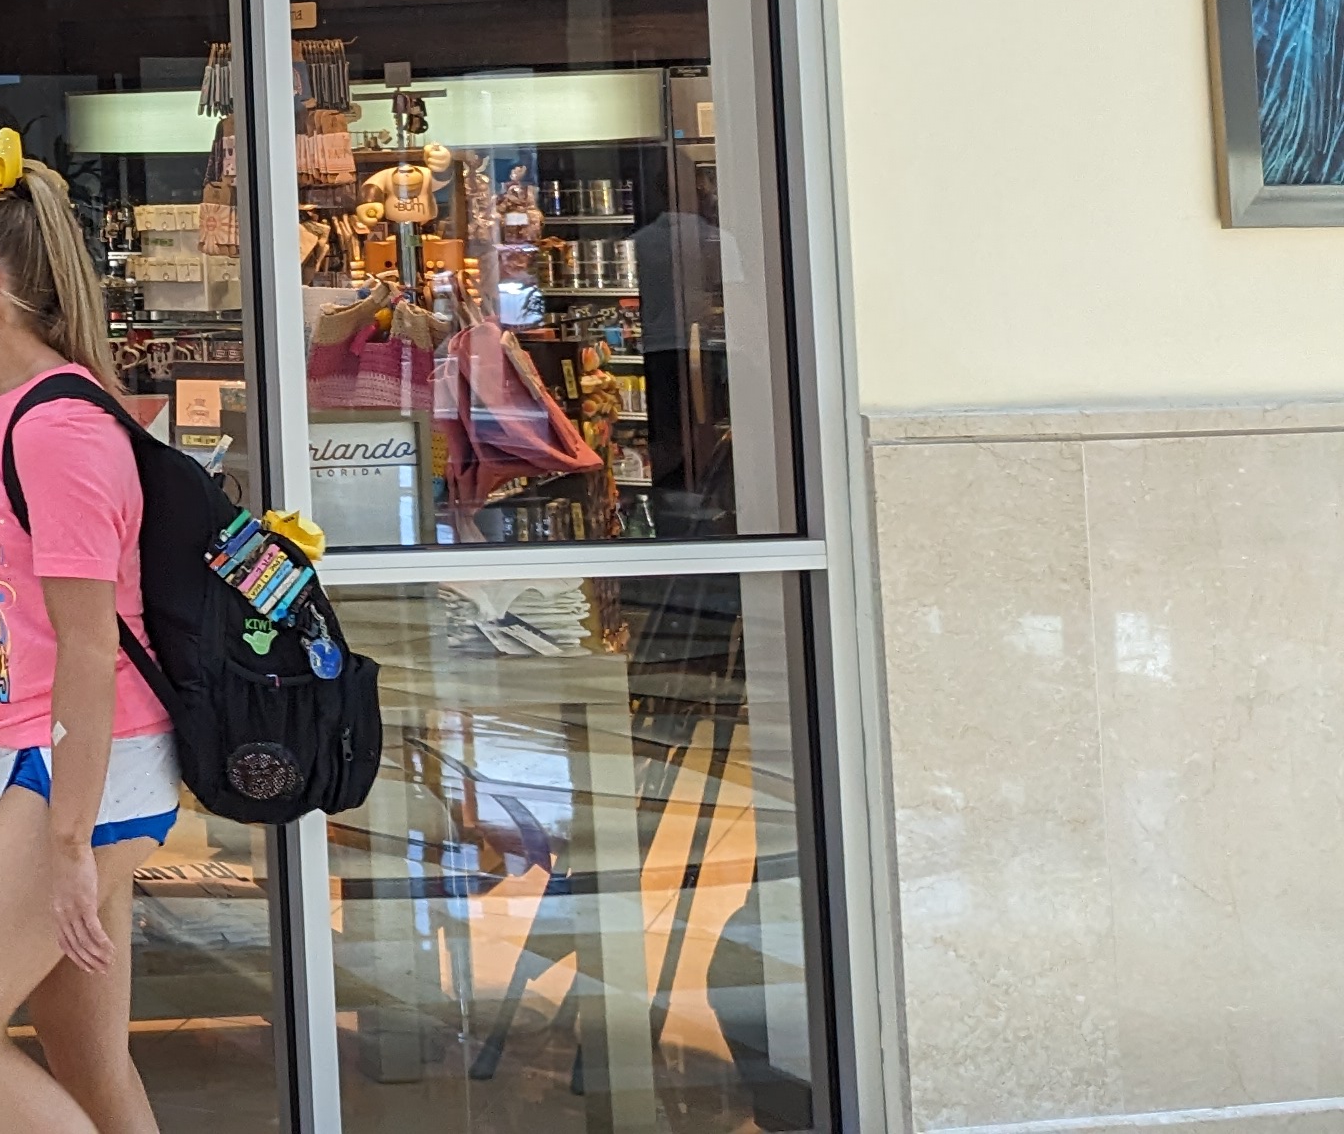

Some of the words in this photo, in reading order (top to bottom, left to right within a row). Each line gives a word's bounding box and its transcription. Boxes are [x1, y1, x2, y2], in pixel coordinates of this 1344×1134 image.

[309, 438, 417, 461] rlando
[316, 468, 372, 478] LORIDA
[245, 618, 273, 631] KIWI
